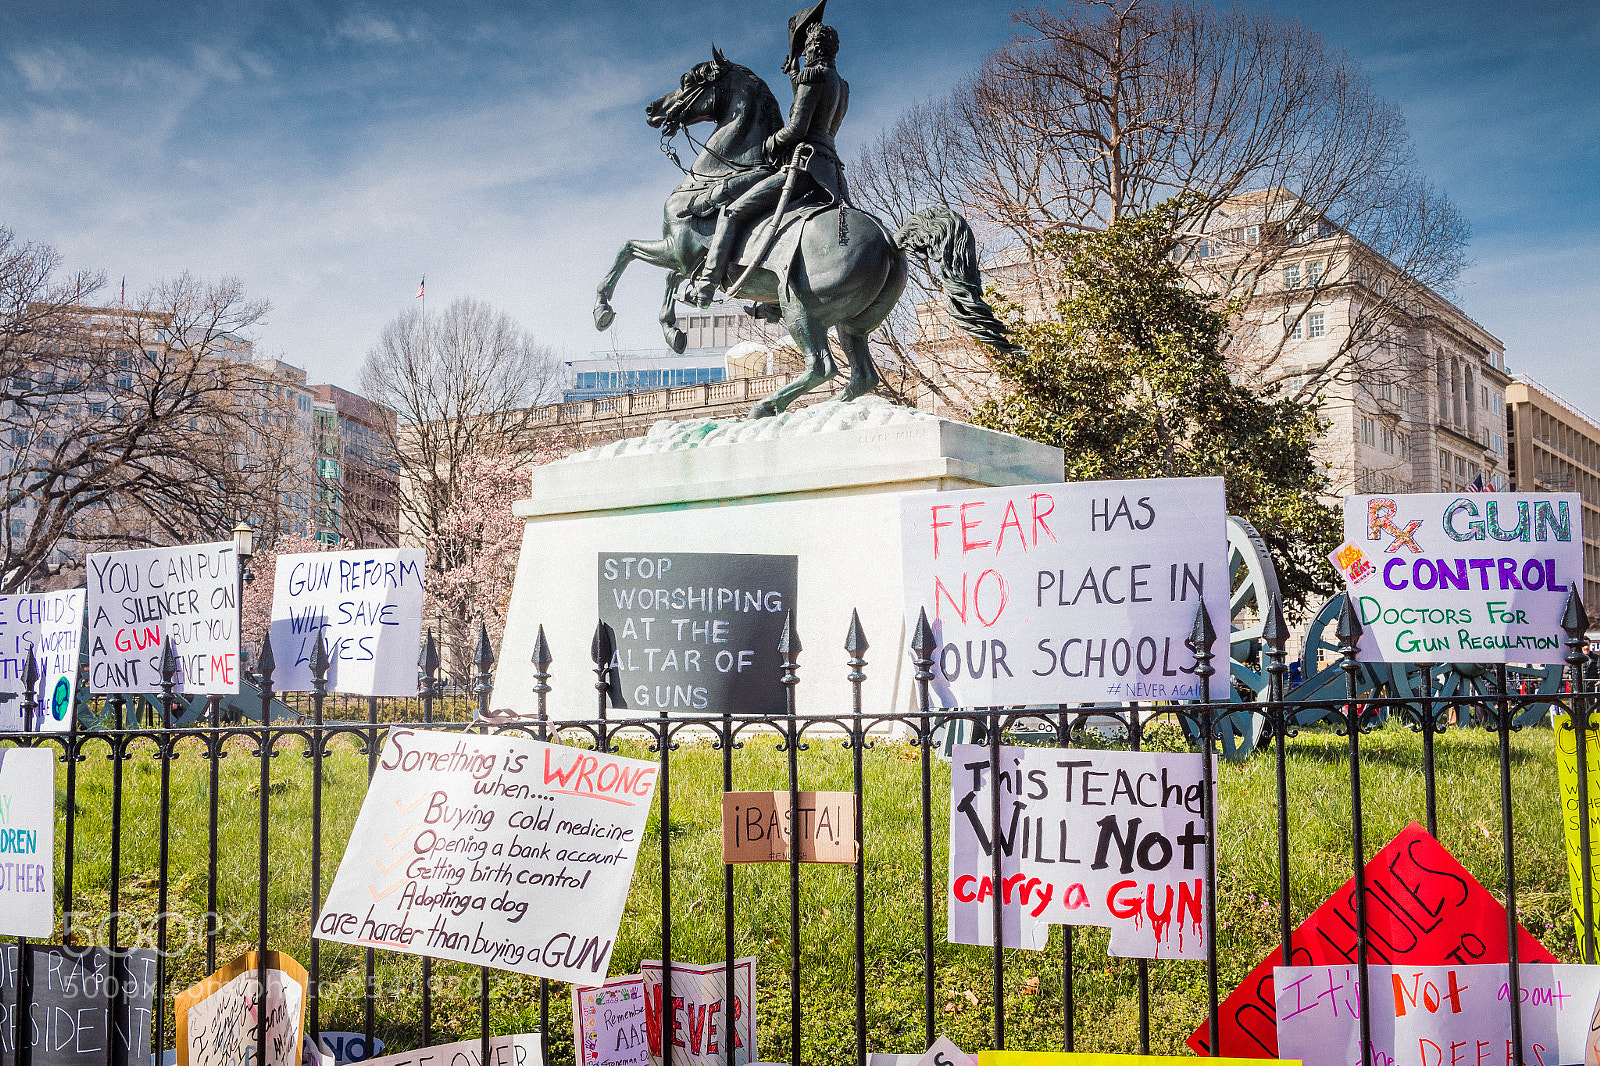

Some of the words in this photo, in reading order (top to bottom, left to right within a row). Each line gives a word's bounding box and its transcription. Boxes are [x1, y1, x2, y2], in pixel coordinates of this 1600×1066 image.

[930, 492, 1058, 560] FEAR
[1091, 495, 1156, 532] HAS
[1442, 498, 1572, 542] GUN
[91, 555, 139, 594] YOU
[148, 554, 194, 588] CAN
[198, 548, 233, 579] PUT
[288, 561, 333, 597] GUN
[339, 559, 424, 594] REFORM
[603, 557, 672, 581] STOP
[1382, 557, 1569, 593] CONTROL
[17, 594, 76, 625] CHILD'S
[93, 605, 113, 628] A
[121, 588, 200, 625] SILENCER
[210, 583, 236, 610] ON
[612, 586, 783, 613] WORSHIPING
[934, 568, 1010, 632] NO
[1037, 563, 1153, 607] PLACE
[1169, 562, 1205, 602] IN
[289, 604, 332, 635] WILL
[337, 600, 400, 626] SAVE
[621, 617, 656, 641] AT
[670, 618, 730, 645] THE
[16, 630, 35, 653] IS
[41, 630, 77, 653] WORTH
[91, 635, 108, 657] A
[115, 624, 161, 653] GUN
[172, 620, 202, 646] BUT
[204, 618, 233, 642] YOU
[294, 636, 374, 667] LVES
[1395, 628, 1450, 653] GUN
[1457, 628, 1560, 651] REGULATION
[0, 656, 48, 679] THN
[53, 653, 76, 674] ALL
[149, 654, 207, 687] SENCE
[210, 653, 236, 685] ME
[609, 648, 701, 673] ALTAR
[714, 649, 756, 673] OF
[939, 638, 1015, 683] OUR
[634, 683, 709, 709] GUNS
[1126, 682, 1167, 697] NEVER
[1171, 683, 1201, 697] AGAI
[381, 730, 497, 779] Something
[502, 748, 529, 773] is
[543, 747, 657, 797] WRONG
[423, 790, 495, 832] Buying
[507, 805, 555, 832] cold
[555, 818, 635, 842] medicine
[957, 791, 1081, 864] WILL
[1090, 814, 1207, 875] Not
[413, 828, 488, 862] Opening
[491, 841, 504, 856] a
[507, 834, 551, 860] bank
[555, 847, 629, 866] account
[406, 856, 466, 886] Getting
[469, 861, 513, 886] birth
[516, 866, 592, 890] control
[397, 880, 474, 917] Adopting
[471, 894, 485, 911] a
[490, 889, 530, 923] dog
[1063, 882, 1091, 910] a
[1106, 878, 1203, 940] GUN
[320, 912, 358, 936] are
[357, 903, 424, 946] harder
[427, 913, 471, 952] than
[470, 921, 525, 966] buying
[526, 948, 541, 963] a
[541, 932, 612, 973] GUN
[1391, 970, 1469, 1018] Not
[603, 1004, 646, 1031] Remembe
[643, 983, 744, 1057] NEVER
